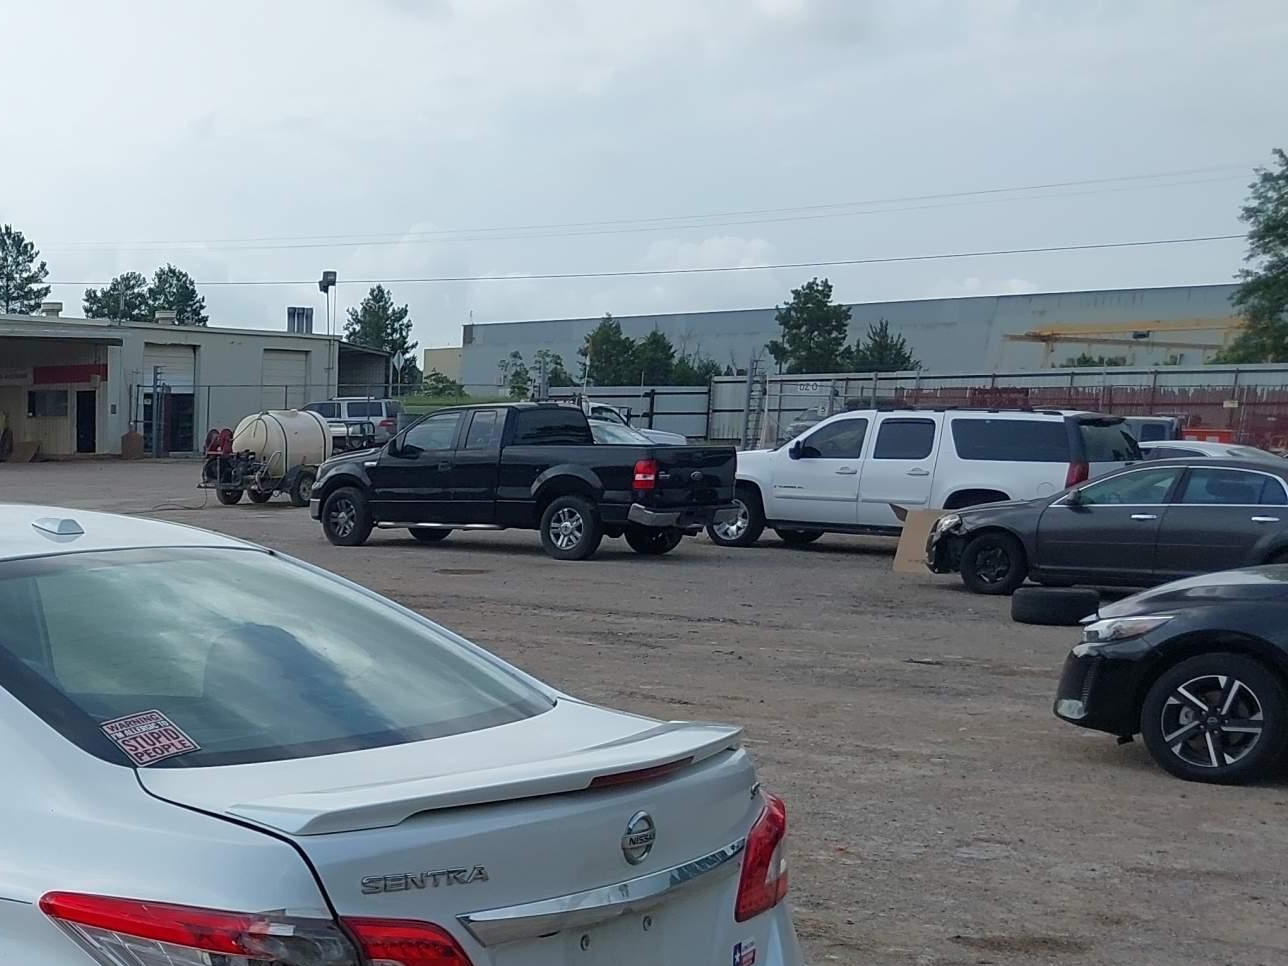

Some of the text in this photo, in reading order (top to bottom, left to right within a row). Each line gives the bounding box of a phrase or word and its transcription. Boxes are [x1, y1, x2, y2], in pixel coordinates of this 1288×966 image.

[106, 714, 160, 732] WARNING
[124, 722, 159, 736] ALLERGIC
[121, 727, 181, 752] STUPID
[133, 739, 191, 761] PEOPLE
[360, 864, 489, 895] SENTRA
